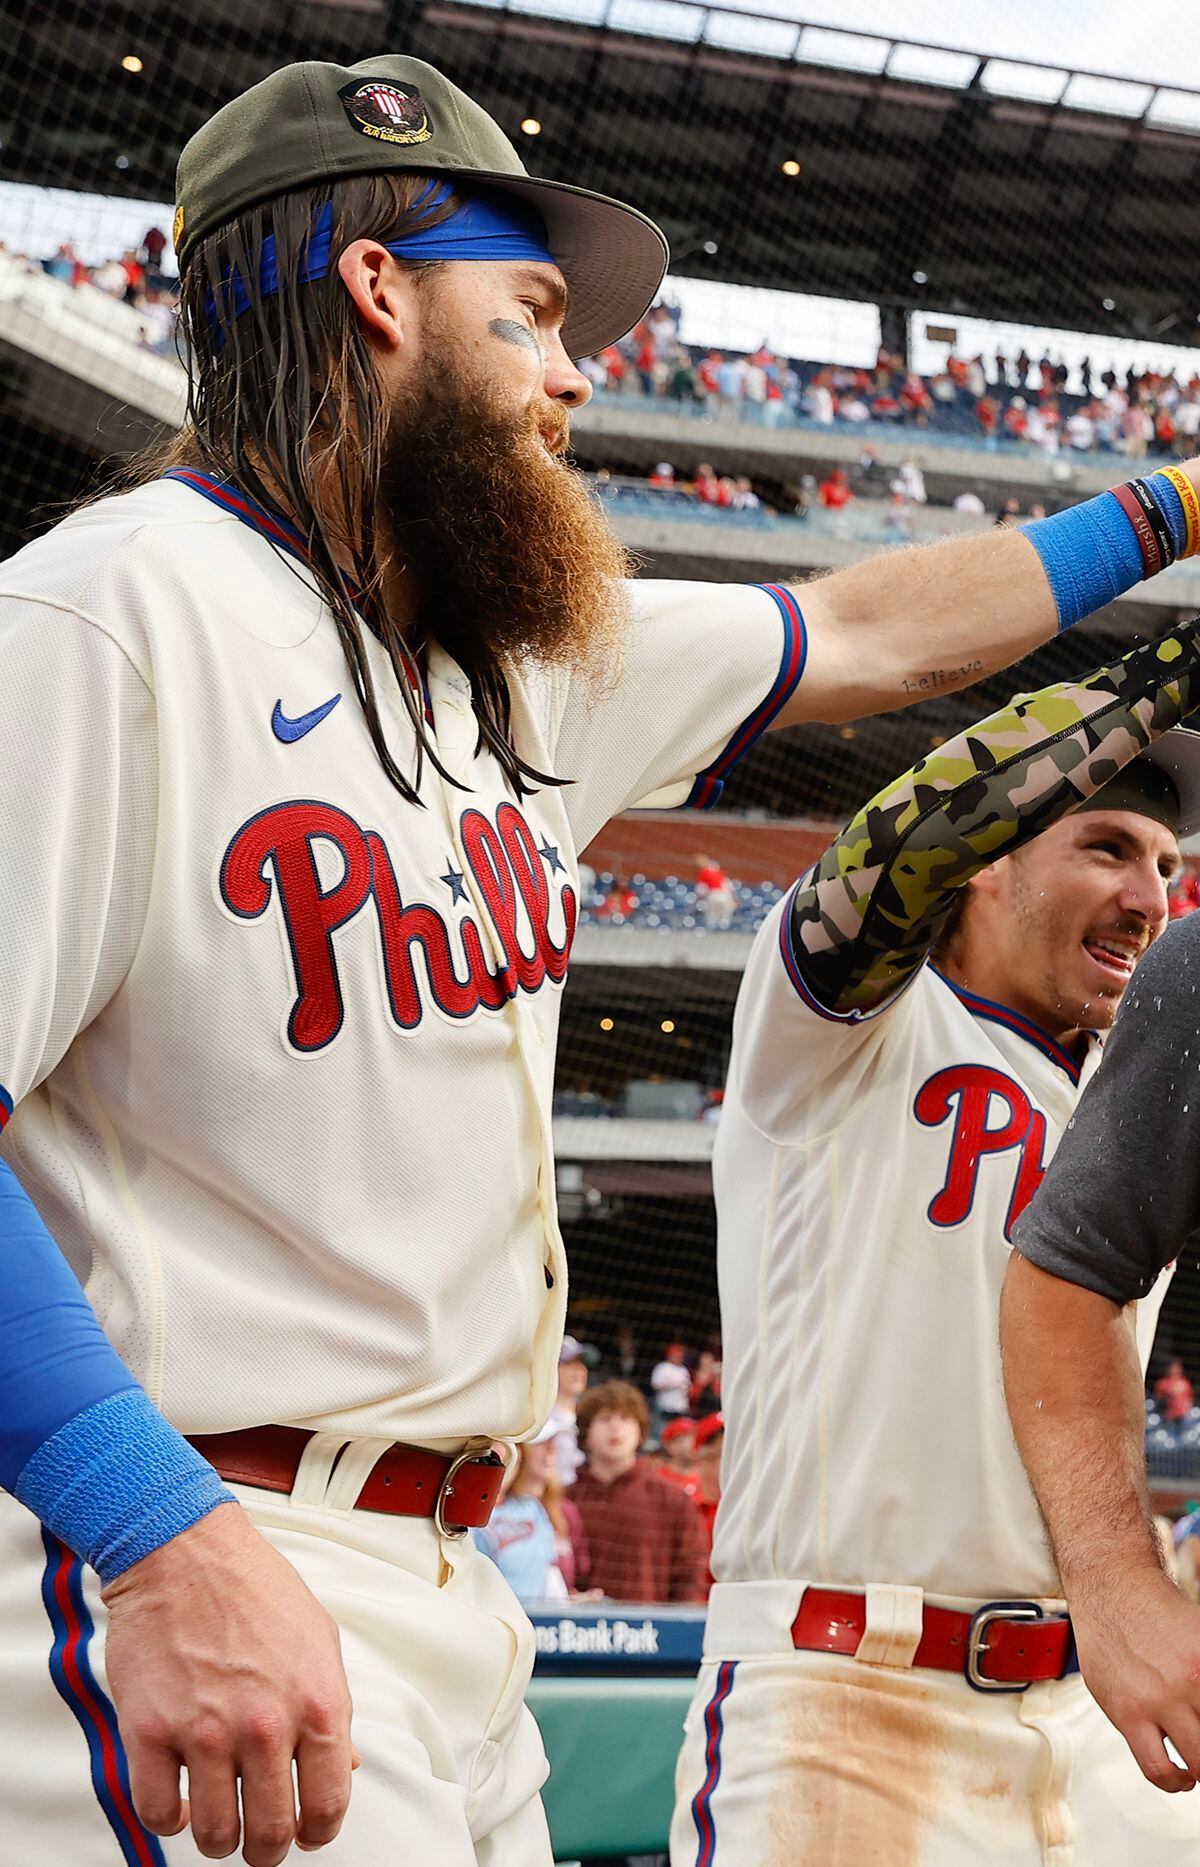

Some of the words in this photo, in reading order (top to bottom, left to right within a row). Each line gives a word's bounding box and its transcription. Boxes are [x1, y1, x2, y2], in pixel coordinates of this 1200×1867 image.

[1135, 484, 1155, 511] Champ!
[1182, 491, 1198, 520] Local
[901, 659, 984, 695] believe
[558, 1618, 613, 1654] Bank
[612, 1618, 660, 1655] Park
